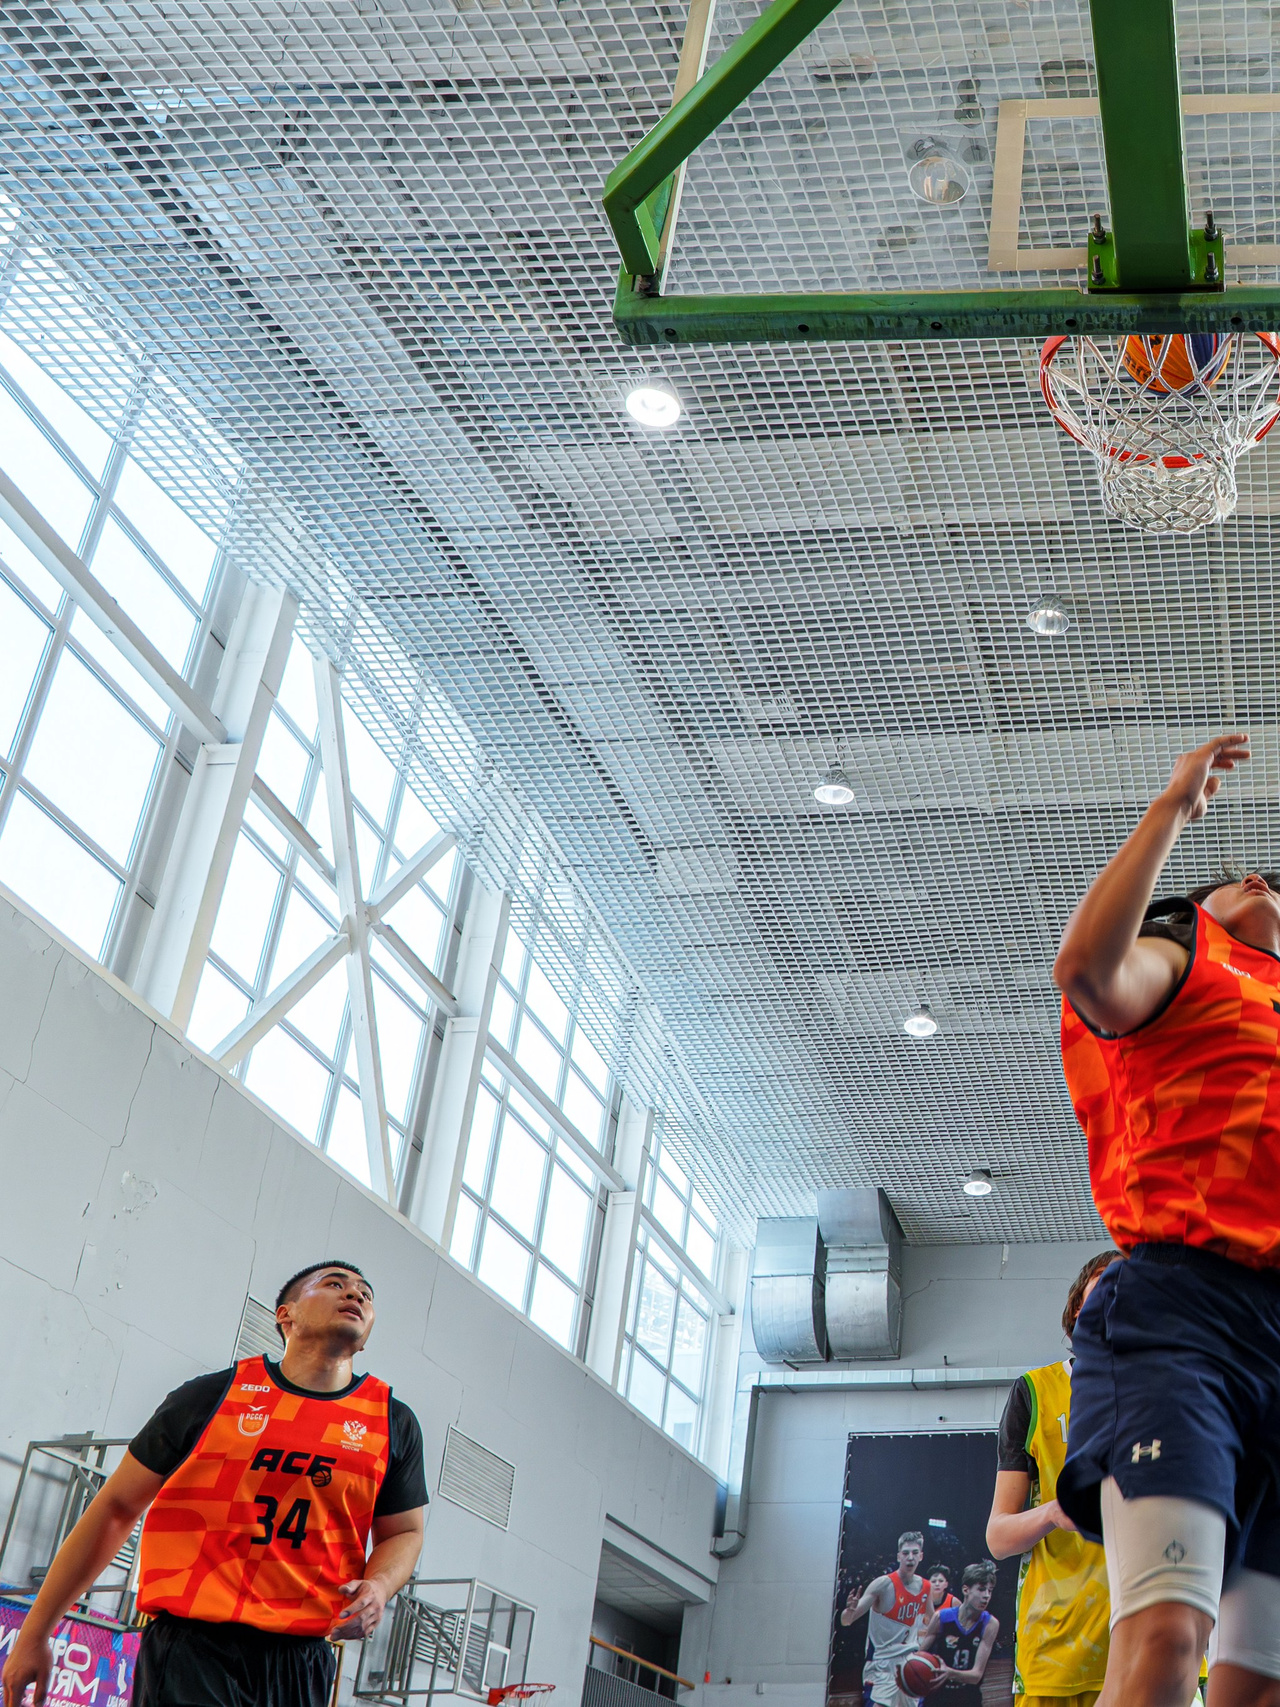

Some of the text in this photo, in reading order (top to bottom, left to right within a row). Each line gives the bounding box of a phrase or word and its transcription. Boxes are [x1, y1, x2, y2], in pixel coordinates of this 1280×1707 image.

[240, 1383, 271, 1394] ZEDO
[250, 1448, 337, 1486] АСБ
[251, 1495, 312, 1550] 34
